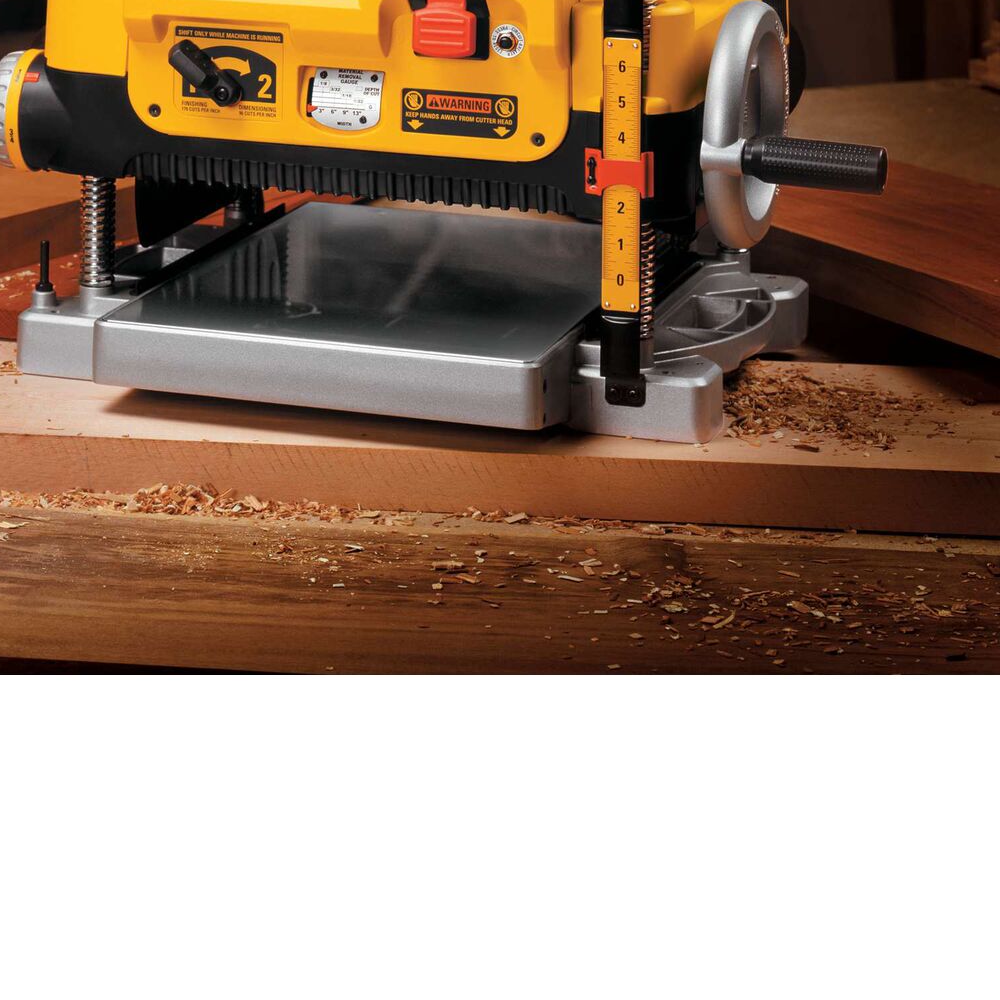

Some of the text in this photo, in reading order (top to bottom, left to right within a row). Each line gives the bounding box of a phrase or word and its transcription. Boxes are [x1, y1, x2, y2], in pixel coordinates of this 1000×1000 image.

[226, 32, 250, 40] MACHINE
[618, 60, 626, 73] 6
[257, 74, 272, 99] 2
[238, 104, 276, 113] DIMENSIONING
[439, 98, 490, 112] WARNING
[618, 96, 626, 109] 5
[420, 112, 440, 120] HANDS
[440, 113, 458, 121] AWAY
[458, 115, 475, 123] FROM
[475, 117, 497, 125] CUTTER
[497, 118, 513, 126] HEAD
[618, 132, 626, 144] 4
[617, 201, 625, 214] 2
[617, 238, 624, 251] 1
[616, 274, 625, 287] 0
